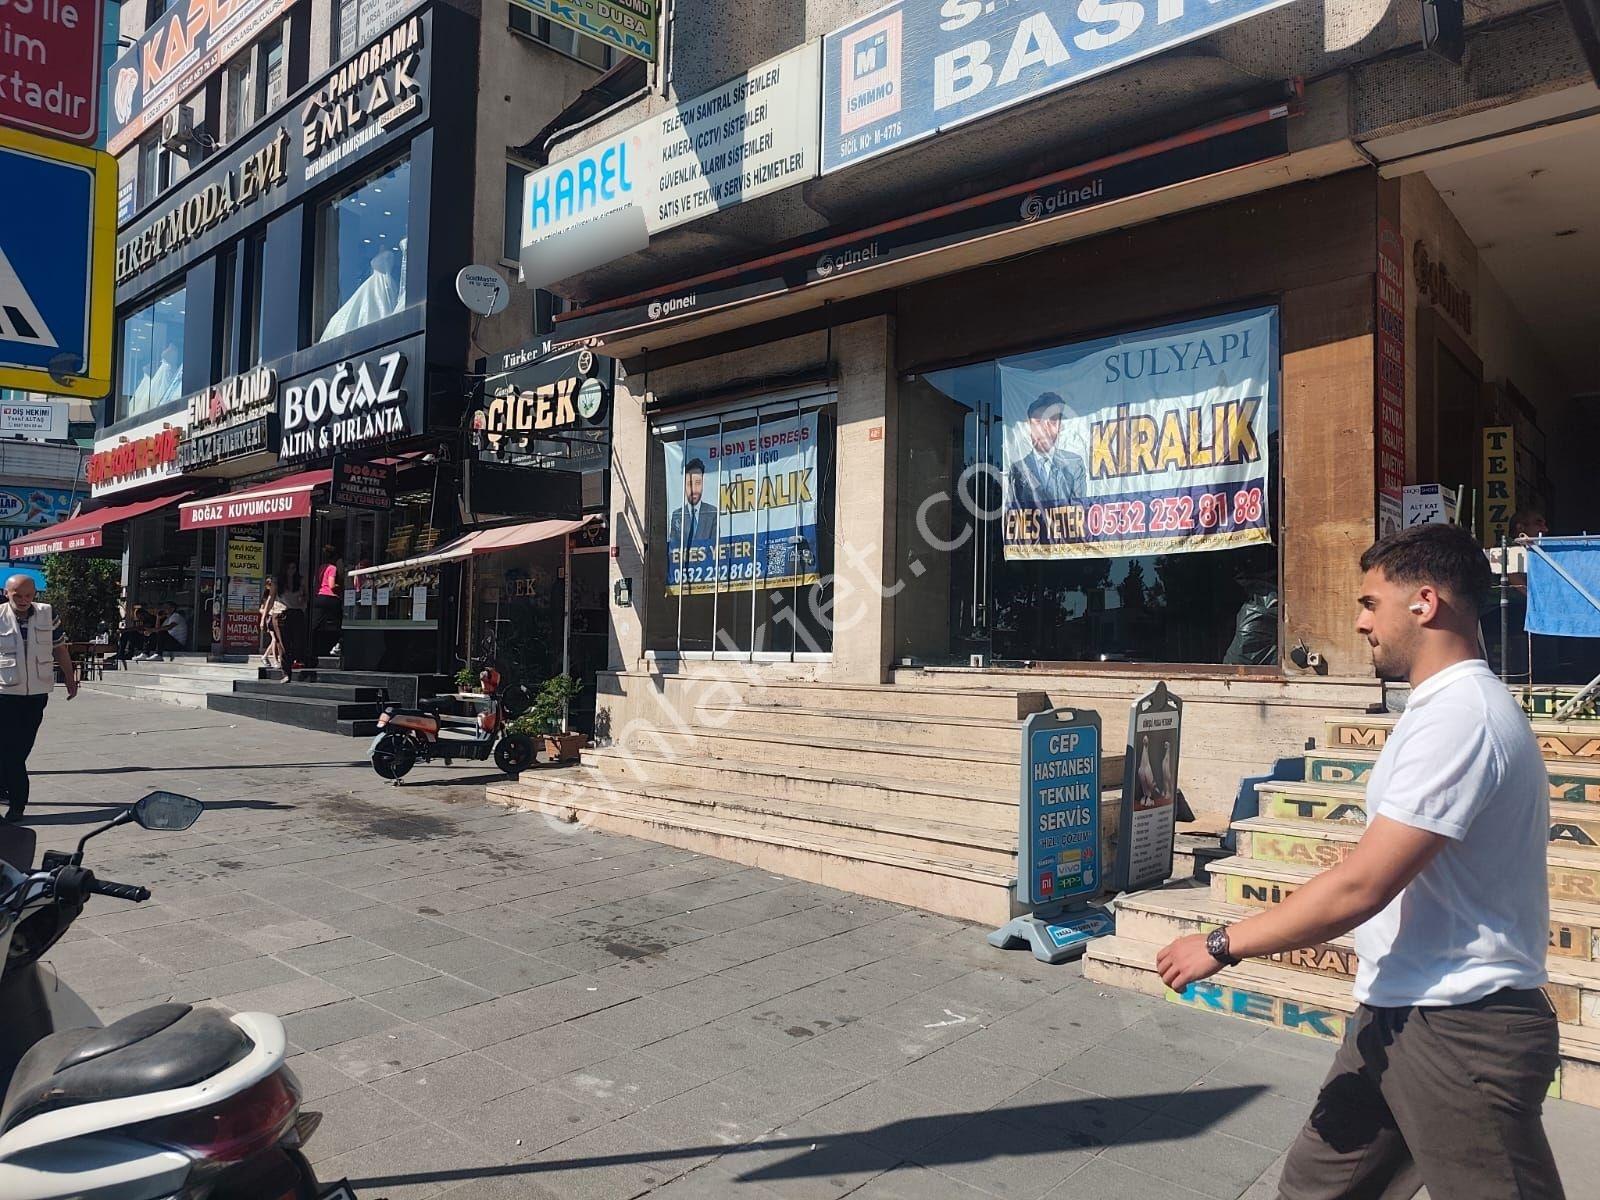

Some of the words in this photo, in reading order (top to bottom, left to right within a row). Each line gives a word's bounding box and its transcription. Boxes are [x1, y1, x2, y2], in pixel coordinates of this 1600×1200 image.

[597, 3, 648, 38] DUBA
[0, 23, 46, 65] im
[329, 16, 419, 101] PANORAMA
[303, 52, 421, 157] EMLAK
[662, 110, 695, 135] TELEFON
[696, 97, 732, 119] SANTRAL
[732, 67, 781, 104] SİSTEMLERİ
[662, 142, 694, 163] KAMERA
[694, 128, 722, 152] (CCTV)
[722, 103, 768, 141] SİSTEMLERİ
[874, 121, 902, 147] M-4776
[659, 163, 698, 193] GÜVENLİK
[699, 156, 727, 178] ALARM
[727, 128, 774, 167] SİSTEMLERİ
[165, 170, 234, 246] MODA
[237, 125, 291, 204] EVİ
[532, 141, 632, 231] KAREL
[658, 203, 680, 221] SATIŞ
[680, 196, 692, 211] VE
[693, 182, 723, 208] TEKNİK
[723, 171, 752, 198] SERVİS
[753, 152, 804, 188] HİZMETLERİ
[1044, 179, 1104, 215] güneli
[834, 240, 879, 271] güneli
[661, 292, 697, 317] güneli
[503, 350, 538, 370] Türker
[1105, 329, 1252, 384] SULYAPI
[284, 351, 403, 431] BOĞAZ
[12, 408, 24, 416] DİŞ
[487, 376, 577, 454] ÇİÇEK
[1382, 404, 1403, 429] FATURA
[280, 428, 315, 459] ALTIN
[318, 427, 330, 448] &
[332, 405, 404, 446] PIRLANTA
[709, 440, 745, 458] BASIN
[1089, 396, 1263, 481] KİRALIK
[343, 463, 387, 479] BOĞAZ
[350, 475, 380, 486] ALTIN
[719, 468, 814, 516] KİRALIK
[192, 503, 222, 523] BOĞAZ
[228, 497, 293, 517] KUYUMCUSU
[1005, 508, 1041, 540] ENES
[1044, 505, 1086, 539] YETER
[1087, 501, 1146, 537] 0532
[1149, 496, 1195, 531] 232
[1198, 492, 1228, 527] 81
[1233, 487, 1263, 524] 88
[227, 624, 259, 634] MATBAA
[1049, 733, 1079, 755] CEP
[1034, 753, 1094, 781] HASTANESİ
[1039, 781, 1090, 806] TEKNİK
[1039, 805, 1091, 832] SERVİS
[1058, 877, 1081, 888] oppo
